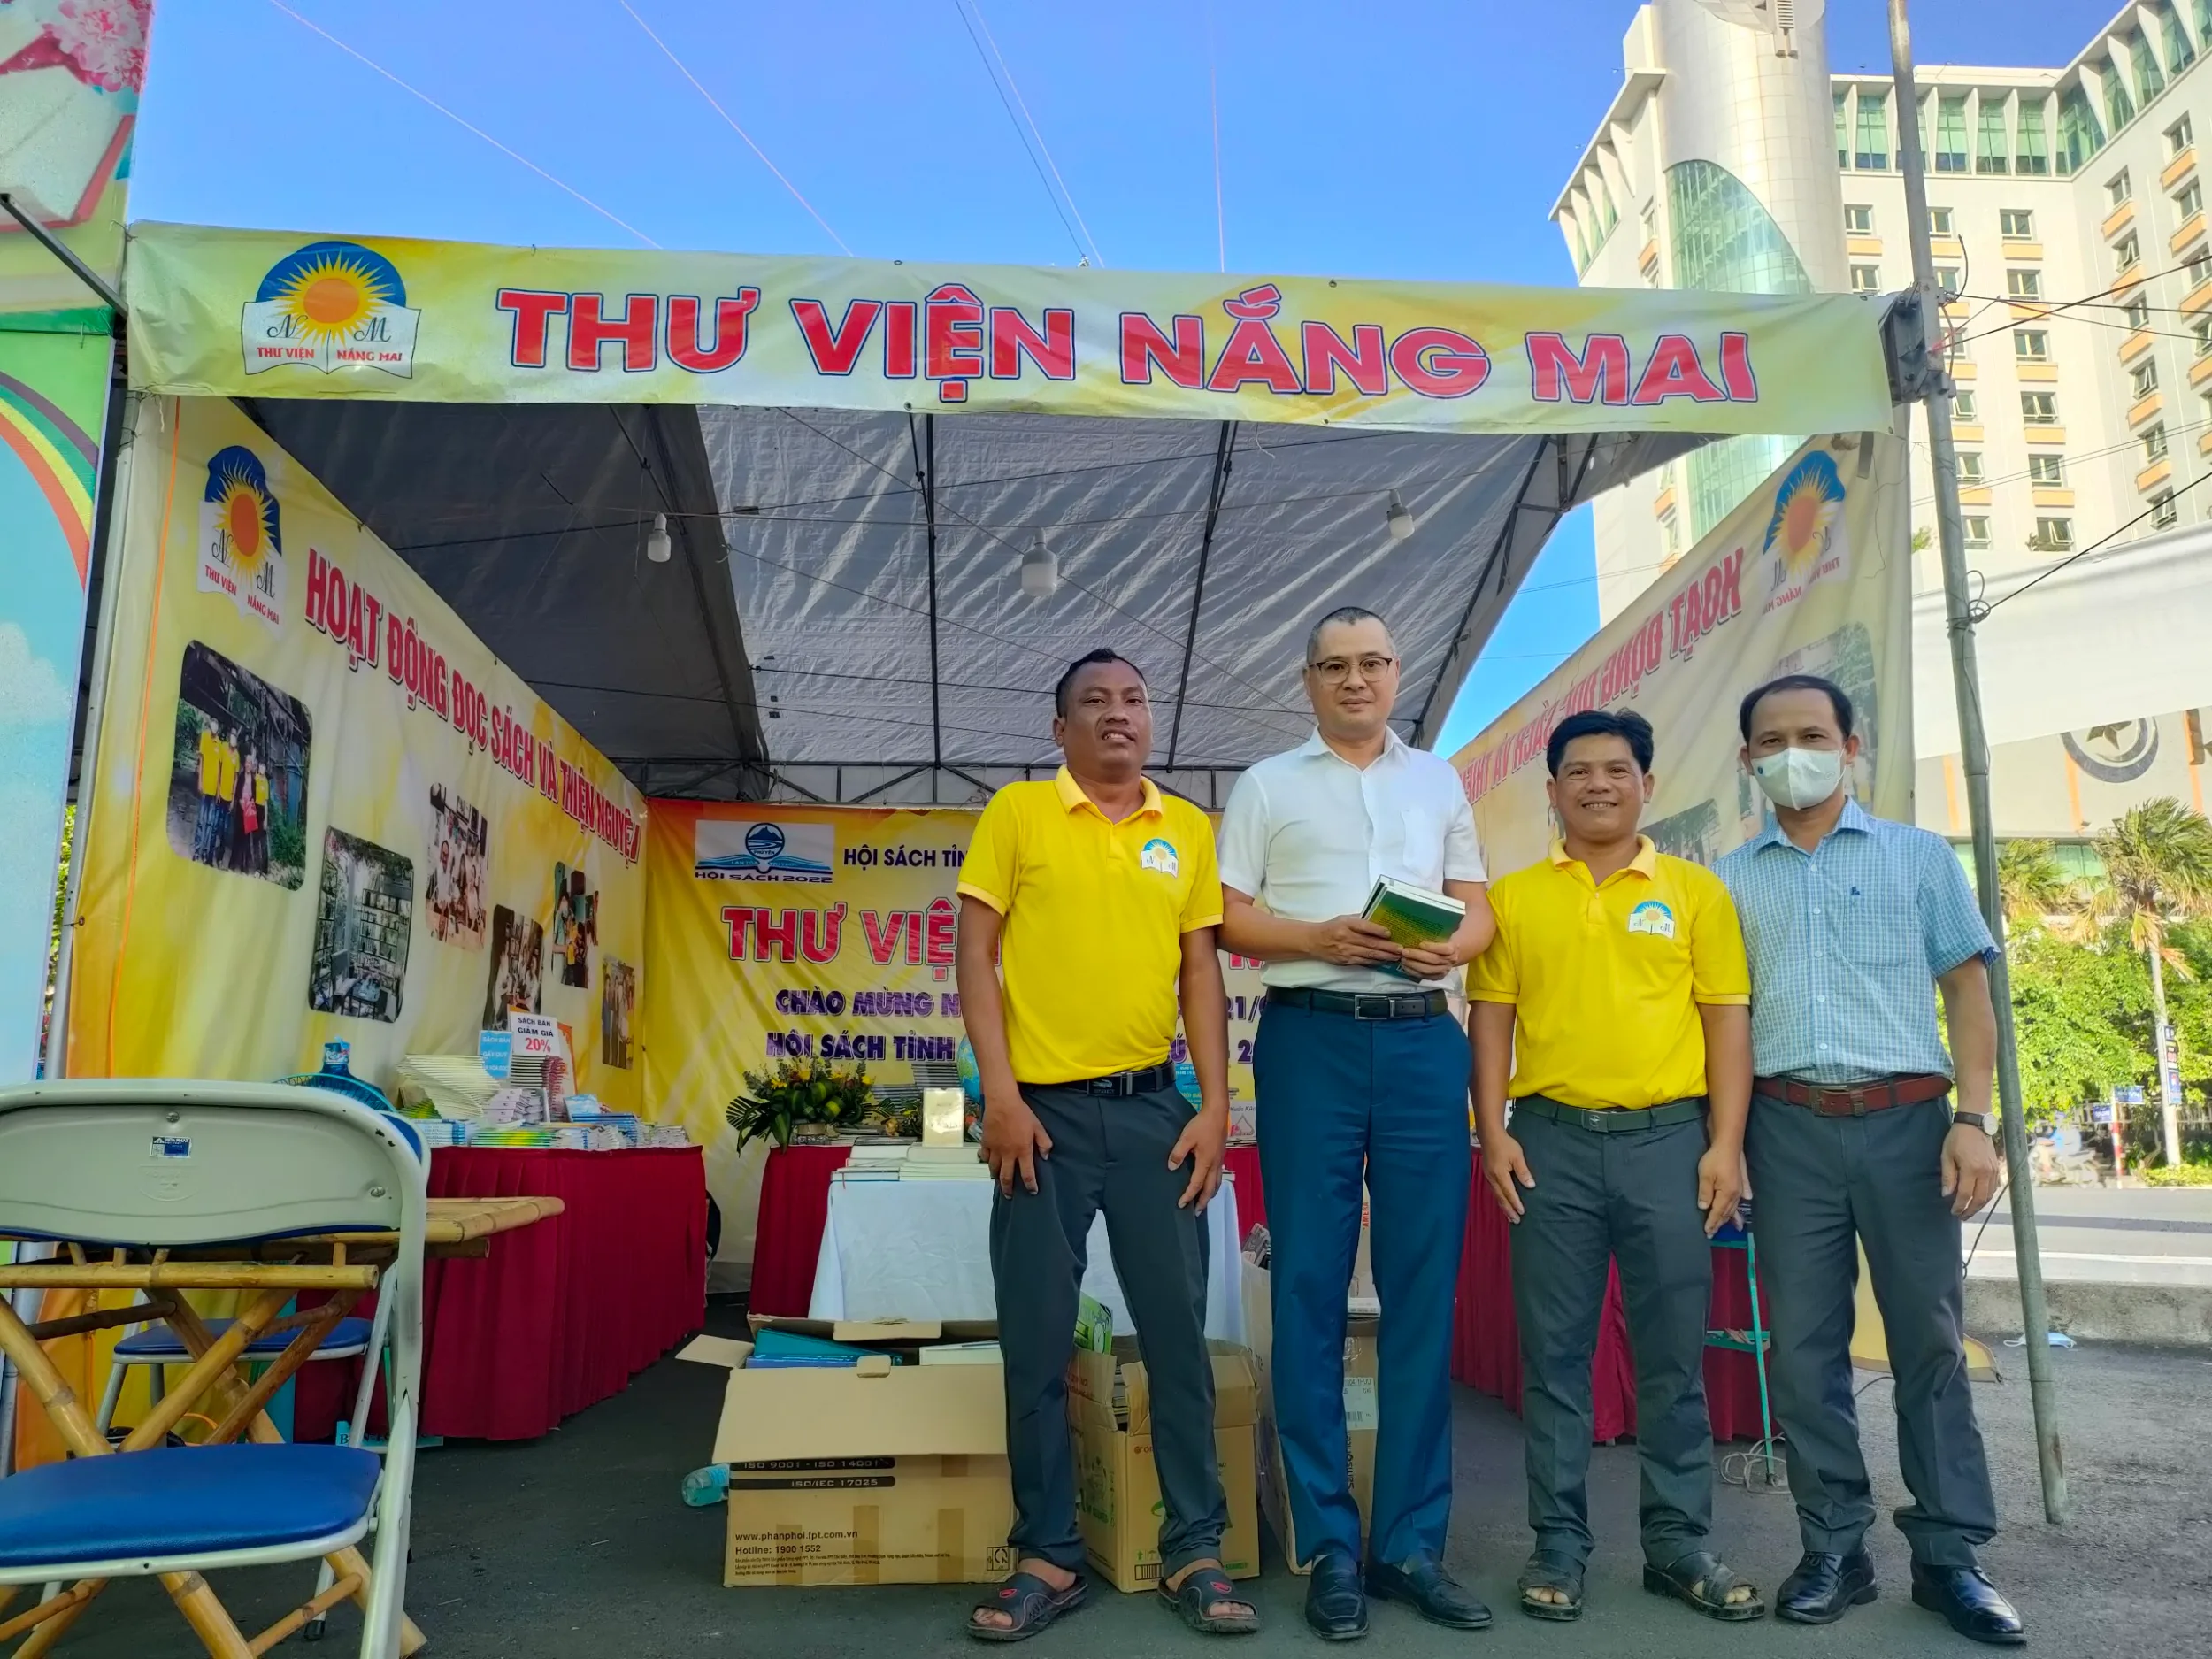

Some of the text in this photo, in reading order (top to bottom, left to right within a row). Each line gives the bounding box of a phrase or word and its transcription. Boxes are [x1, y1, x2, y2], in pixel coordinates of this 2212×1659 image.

[496, 283, 1758, 406] THƯ VIỆN NẮNG MAI
[285, 348, 315, 361] VIỆN
[379, 352, 403, 362] MAI
[304, 547, 383, 672] HOẠT
[386, 611, 449, 722] ĐỘNG
[452, 669, 488, 756] ĐỌC
[490, 704, 535, 788] SÁCH
[538, 740, 559, 805] VÀ
[559, 758, 596, 834] THIỆN
[843, 843, 968, 870] HỘI SÁCH TỈN
[695, 871, 833, 884] HỘI SÁCH 2022
[721, 896, 1002, 982] THƯ VIỆ
[775, 986, 847, 1017] CHÀO
[851, 986, 935, 1017] MỪNG
[518, 1017, 536, 1025] SÁCH
[525, 1037, 551, 1053] 20%
[819, 1029, 886, 1061] SÁCH
[893, 1029, 956, 1061] TỈNH
[791, 1478, 879, 1488] ISO/IEC 17025
[735, 1530, 858, 1542] www.phanphoi.fpt.com.vn
[735, 1546, 772, 1555] Hotline:
[775, 1545, 797, 1554] 1900
